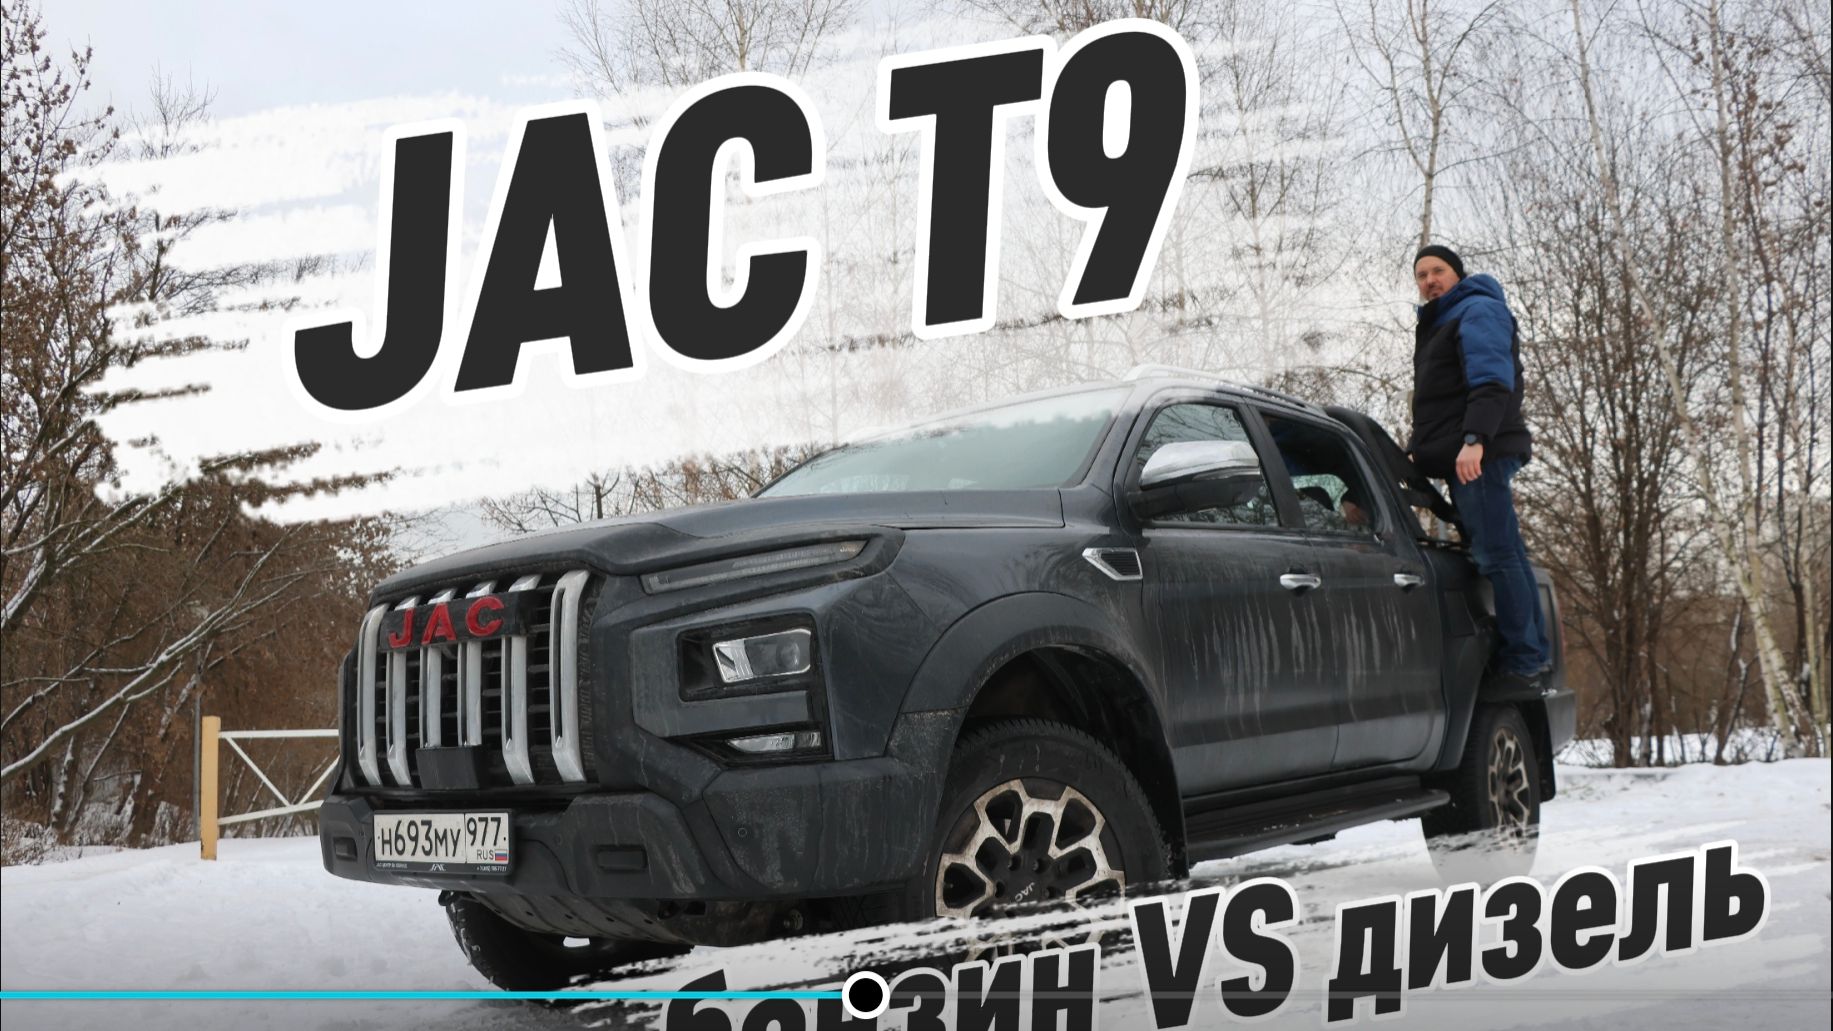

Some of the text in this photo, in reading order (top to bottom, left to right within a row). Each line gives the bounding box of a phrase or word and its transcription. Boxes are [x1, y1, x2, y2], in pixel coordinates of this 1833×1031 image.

[388, 595, 505, 648] JAC
[380, 816, 502, 857] Н693МУ 977
[476, 849, 495, 861] RUS
[1014, 881, 1036, 902] JAC
